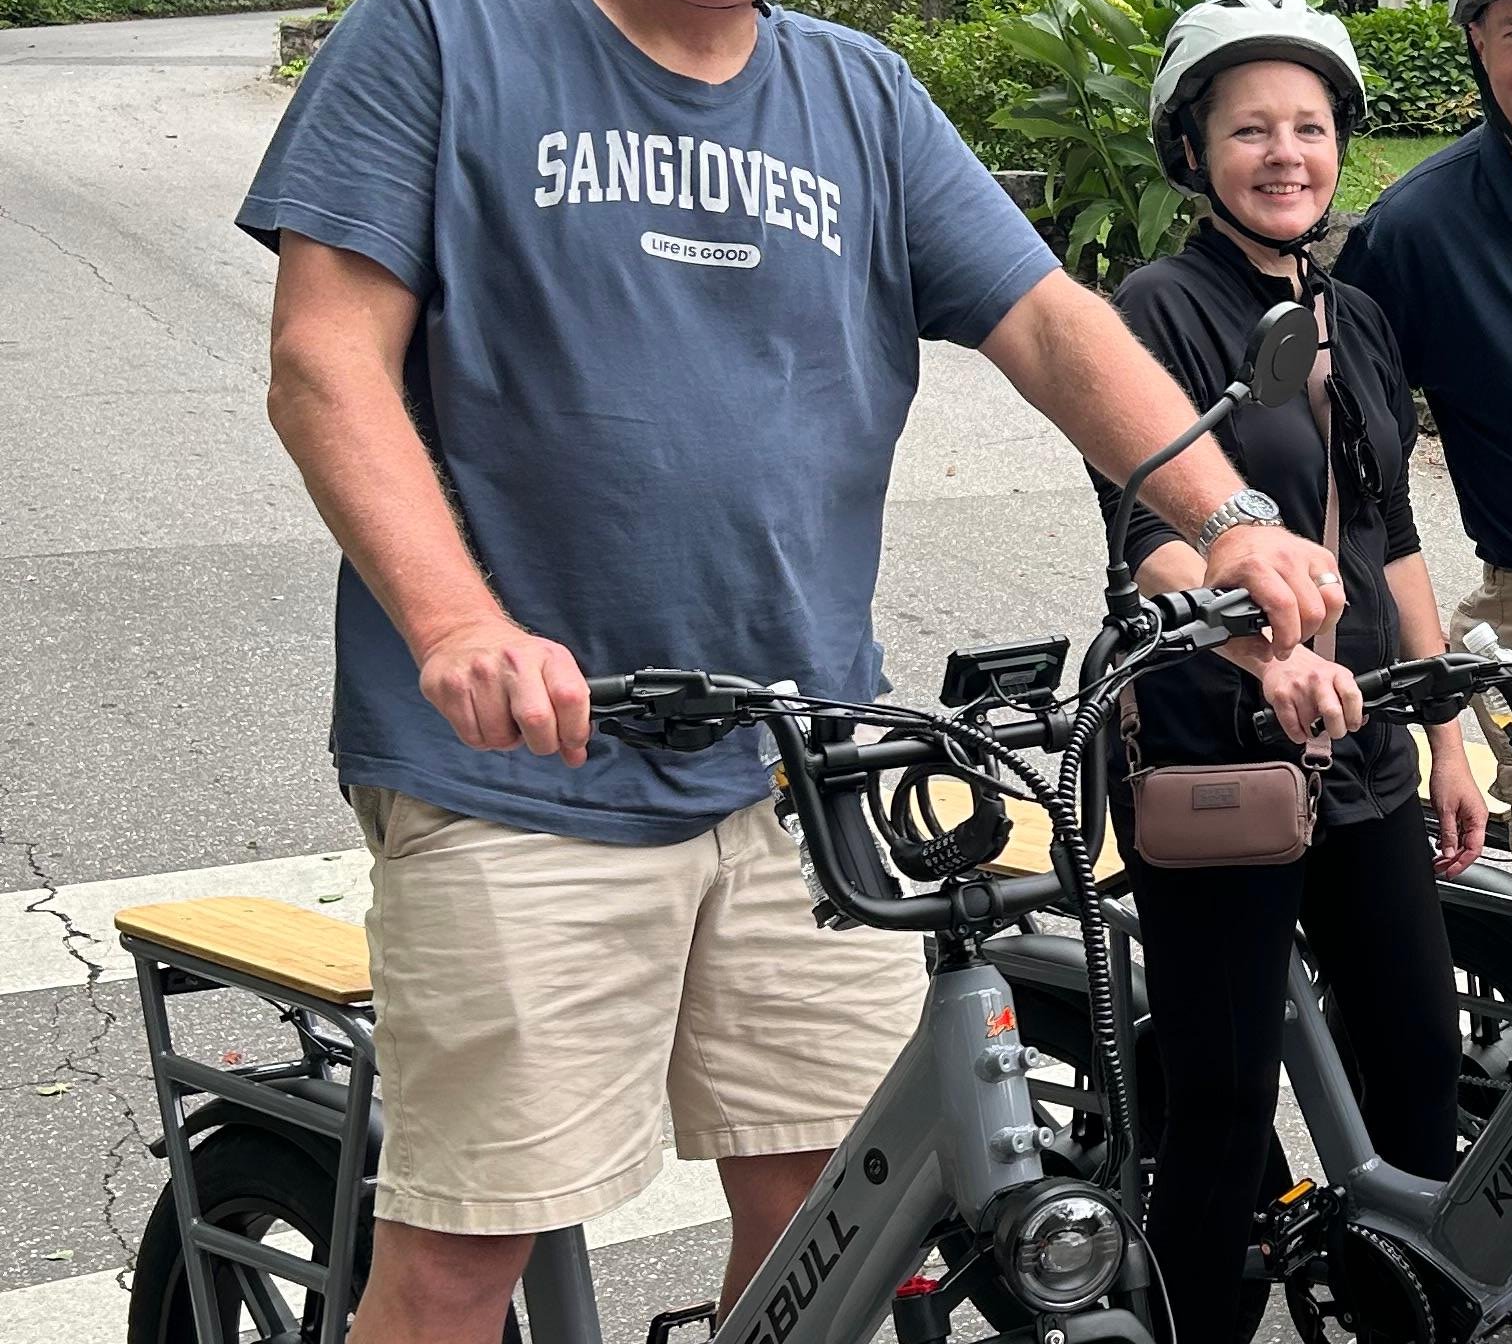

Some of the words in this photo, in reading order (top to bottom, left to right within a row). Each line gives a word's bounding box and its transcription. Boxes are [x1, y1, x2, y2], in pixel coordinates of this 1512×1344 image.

[535, 129, 842, 257] SANGIOVESE
[683, 245, 697, 257] IS
[700, 247, 749, 262] GOOD
